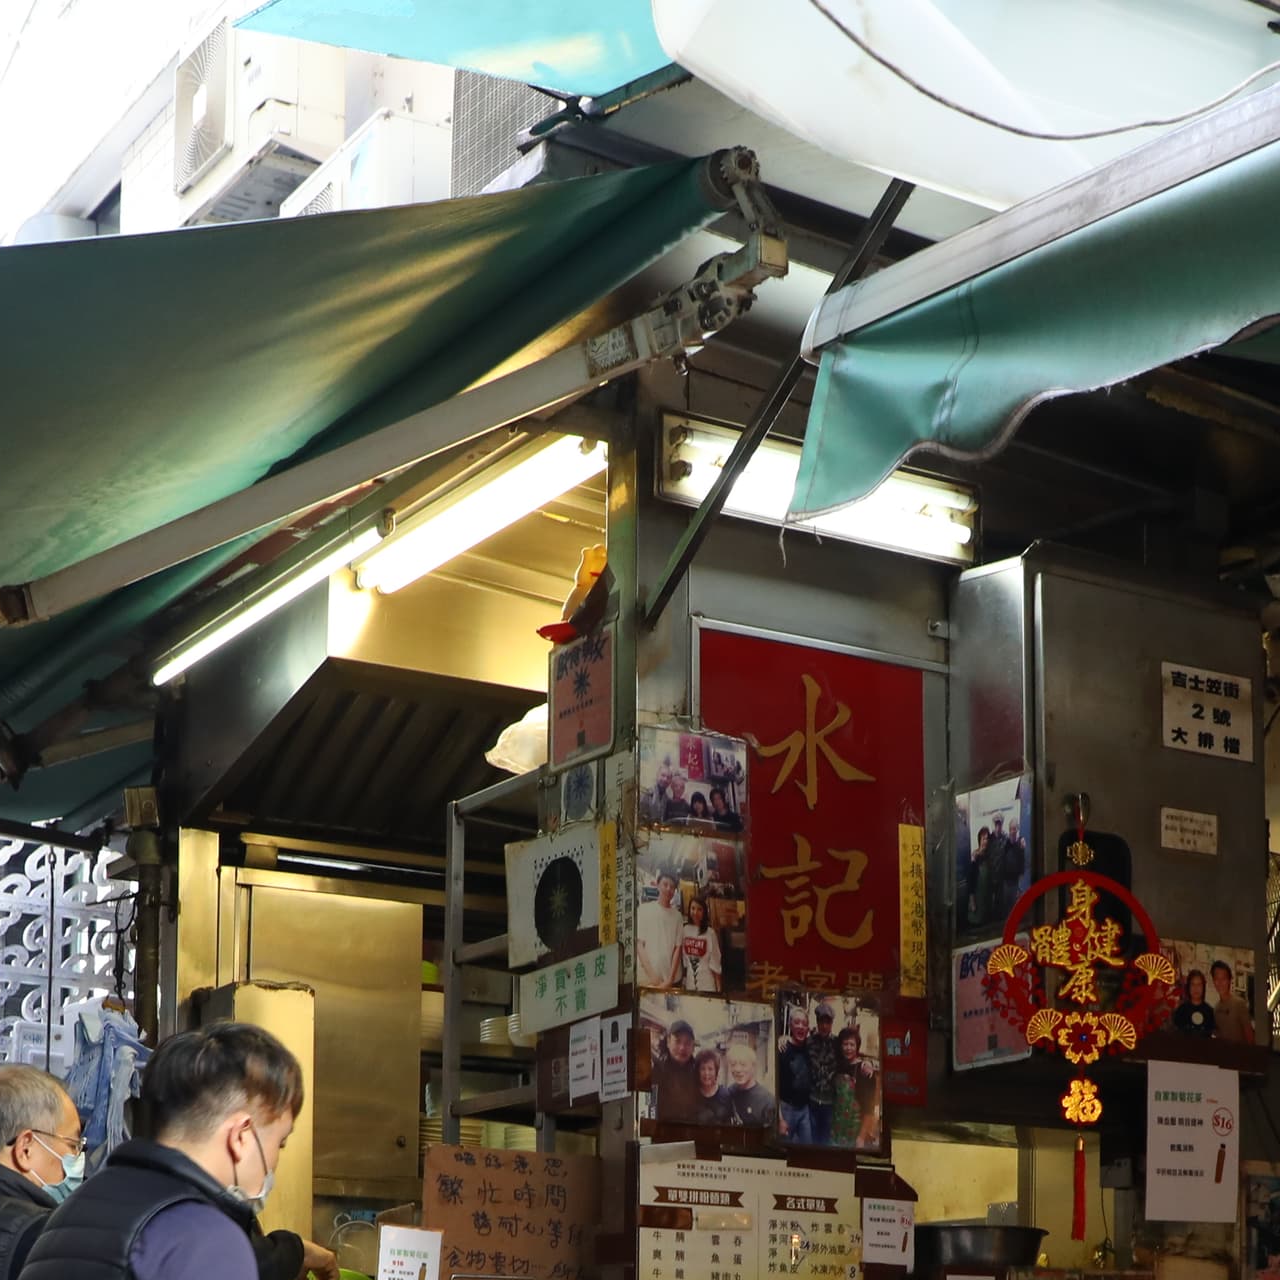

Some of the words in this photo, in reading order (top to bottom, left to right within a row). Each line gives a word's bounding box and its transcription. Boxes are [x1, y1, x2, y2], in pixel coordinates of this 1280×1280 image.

[1192, 703, 1205, 720] 2
[756, 674, 877, 949] 水記
[745, 959, 885, 999] 老字號
[1062, 1079, 1104, 1125] 福
[1213, 1114, 1232, 1130] $16
[437, 1172, 567, 1213] 繁忙時間
